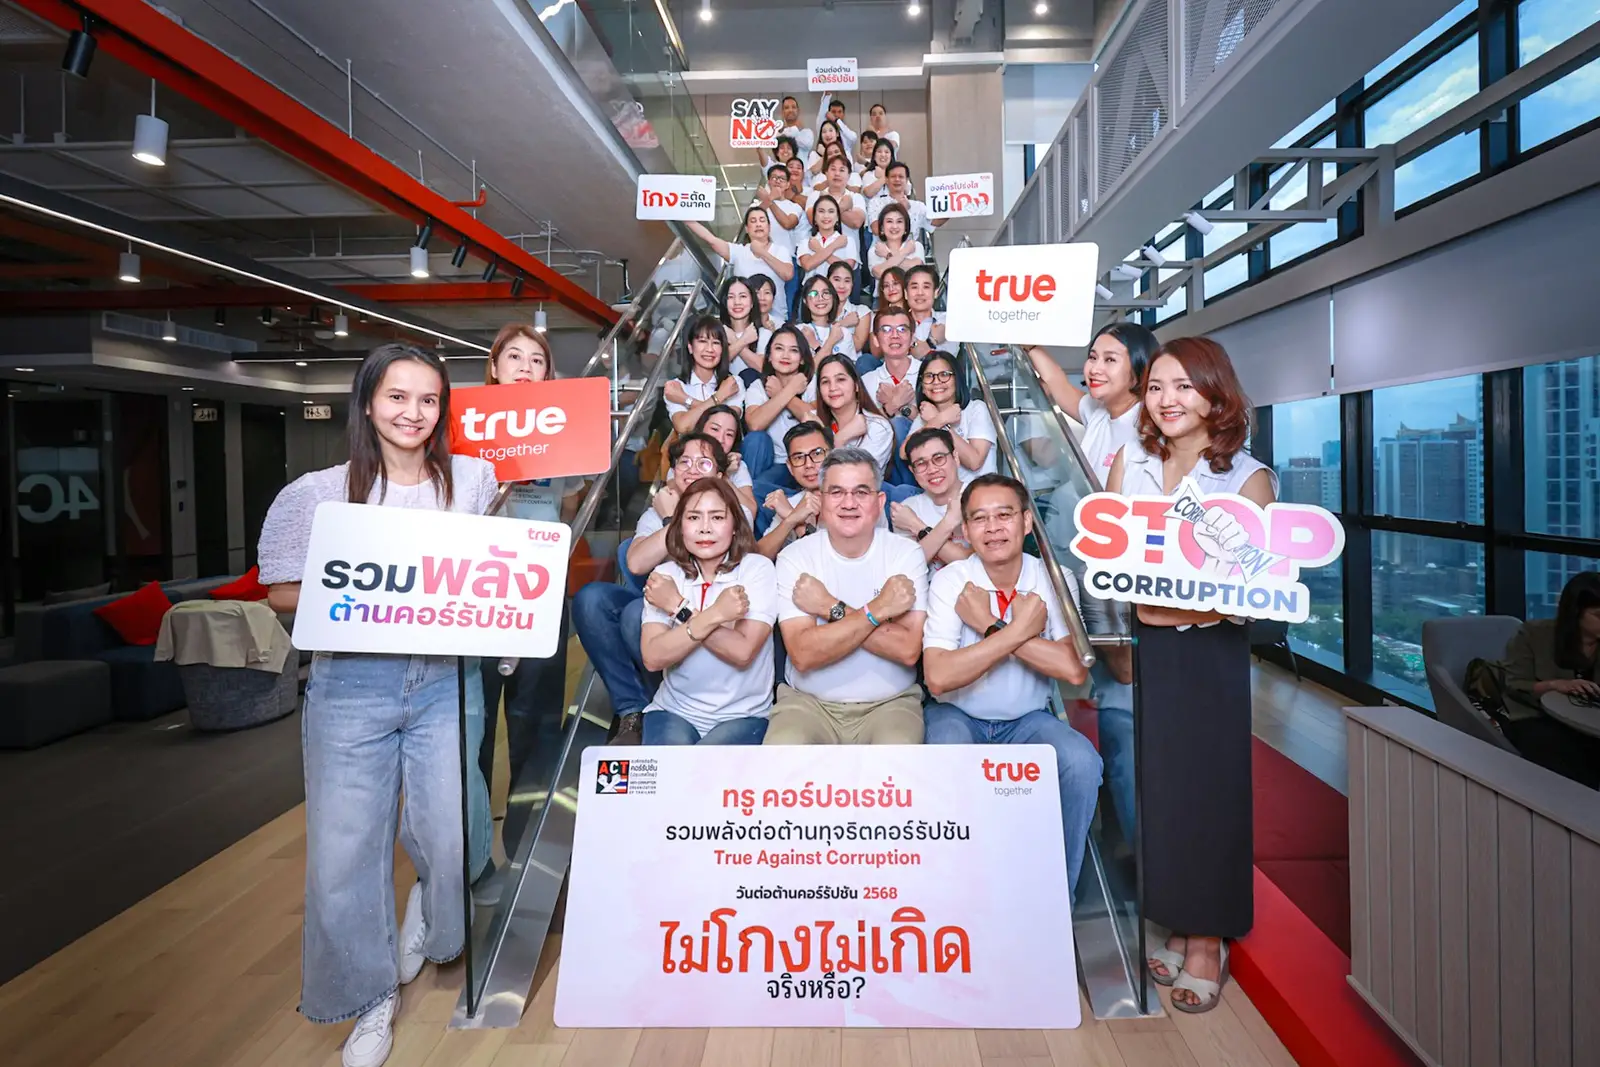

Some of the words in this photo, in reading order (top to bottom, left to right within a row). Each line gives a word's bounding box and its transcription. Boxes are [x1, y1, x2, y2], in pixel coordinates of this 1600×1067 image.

[733, 101, 777, 118] SAY
[732, 119, 776, 140] NO
[976, 269, 1056, 302] true
[988, 309, 1041, 323] together
[461, 406, 567, 441] true
[479, 443, 549, 460] together
[528, 528, 560, 542] true
[1076, 498, 1336, 577] STOP
[321, 545, 550, 600] รวมพลัง
[1092, 571, 1297, 613] CORRUPTION
[329, 594, 534, 630] ต้านคอร์รัปชัน
[599, 761, 629, 775] ACT
[981, 758, 1040, 781] true
[722, 788, 755, 816] ทรู
[763, 776, 912, 808] คอร์ปอเรชั่น
[994, 786, 1033, 796] together
[666, 820, 970, 846] รวมพลังต่อต้านทุจริตคอร์รัปชัน
[714, 850, 753, 865] True
[757, 849, 822, 868] Against
[826, 849, 921, 868] Corruption
[736, 886, 858, 900] วันต่อต้านคอร์รัปชัน
[863, 887, 898, 899] 2568
[659, 906, 971, 974] ไม่โกงไม่เกิด
[767, 971, 866, 999] จริงหรือ?
